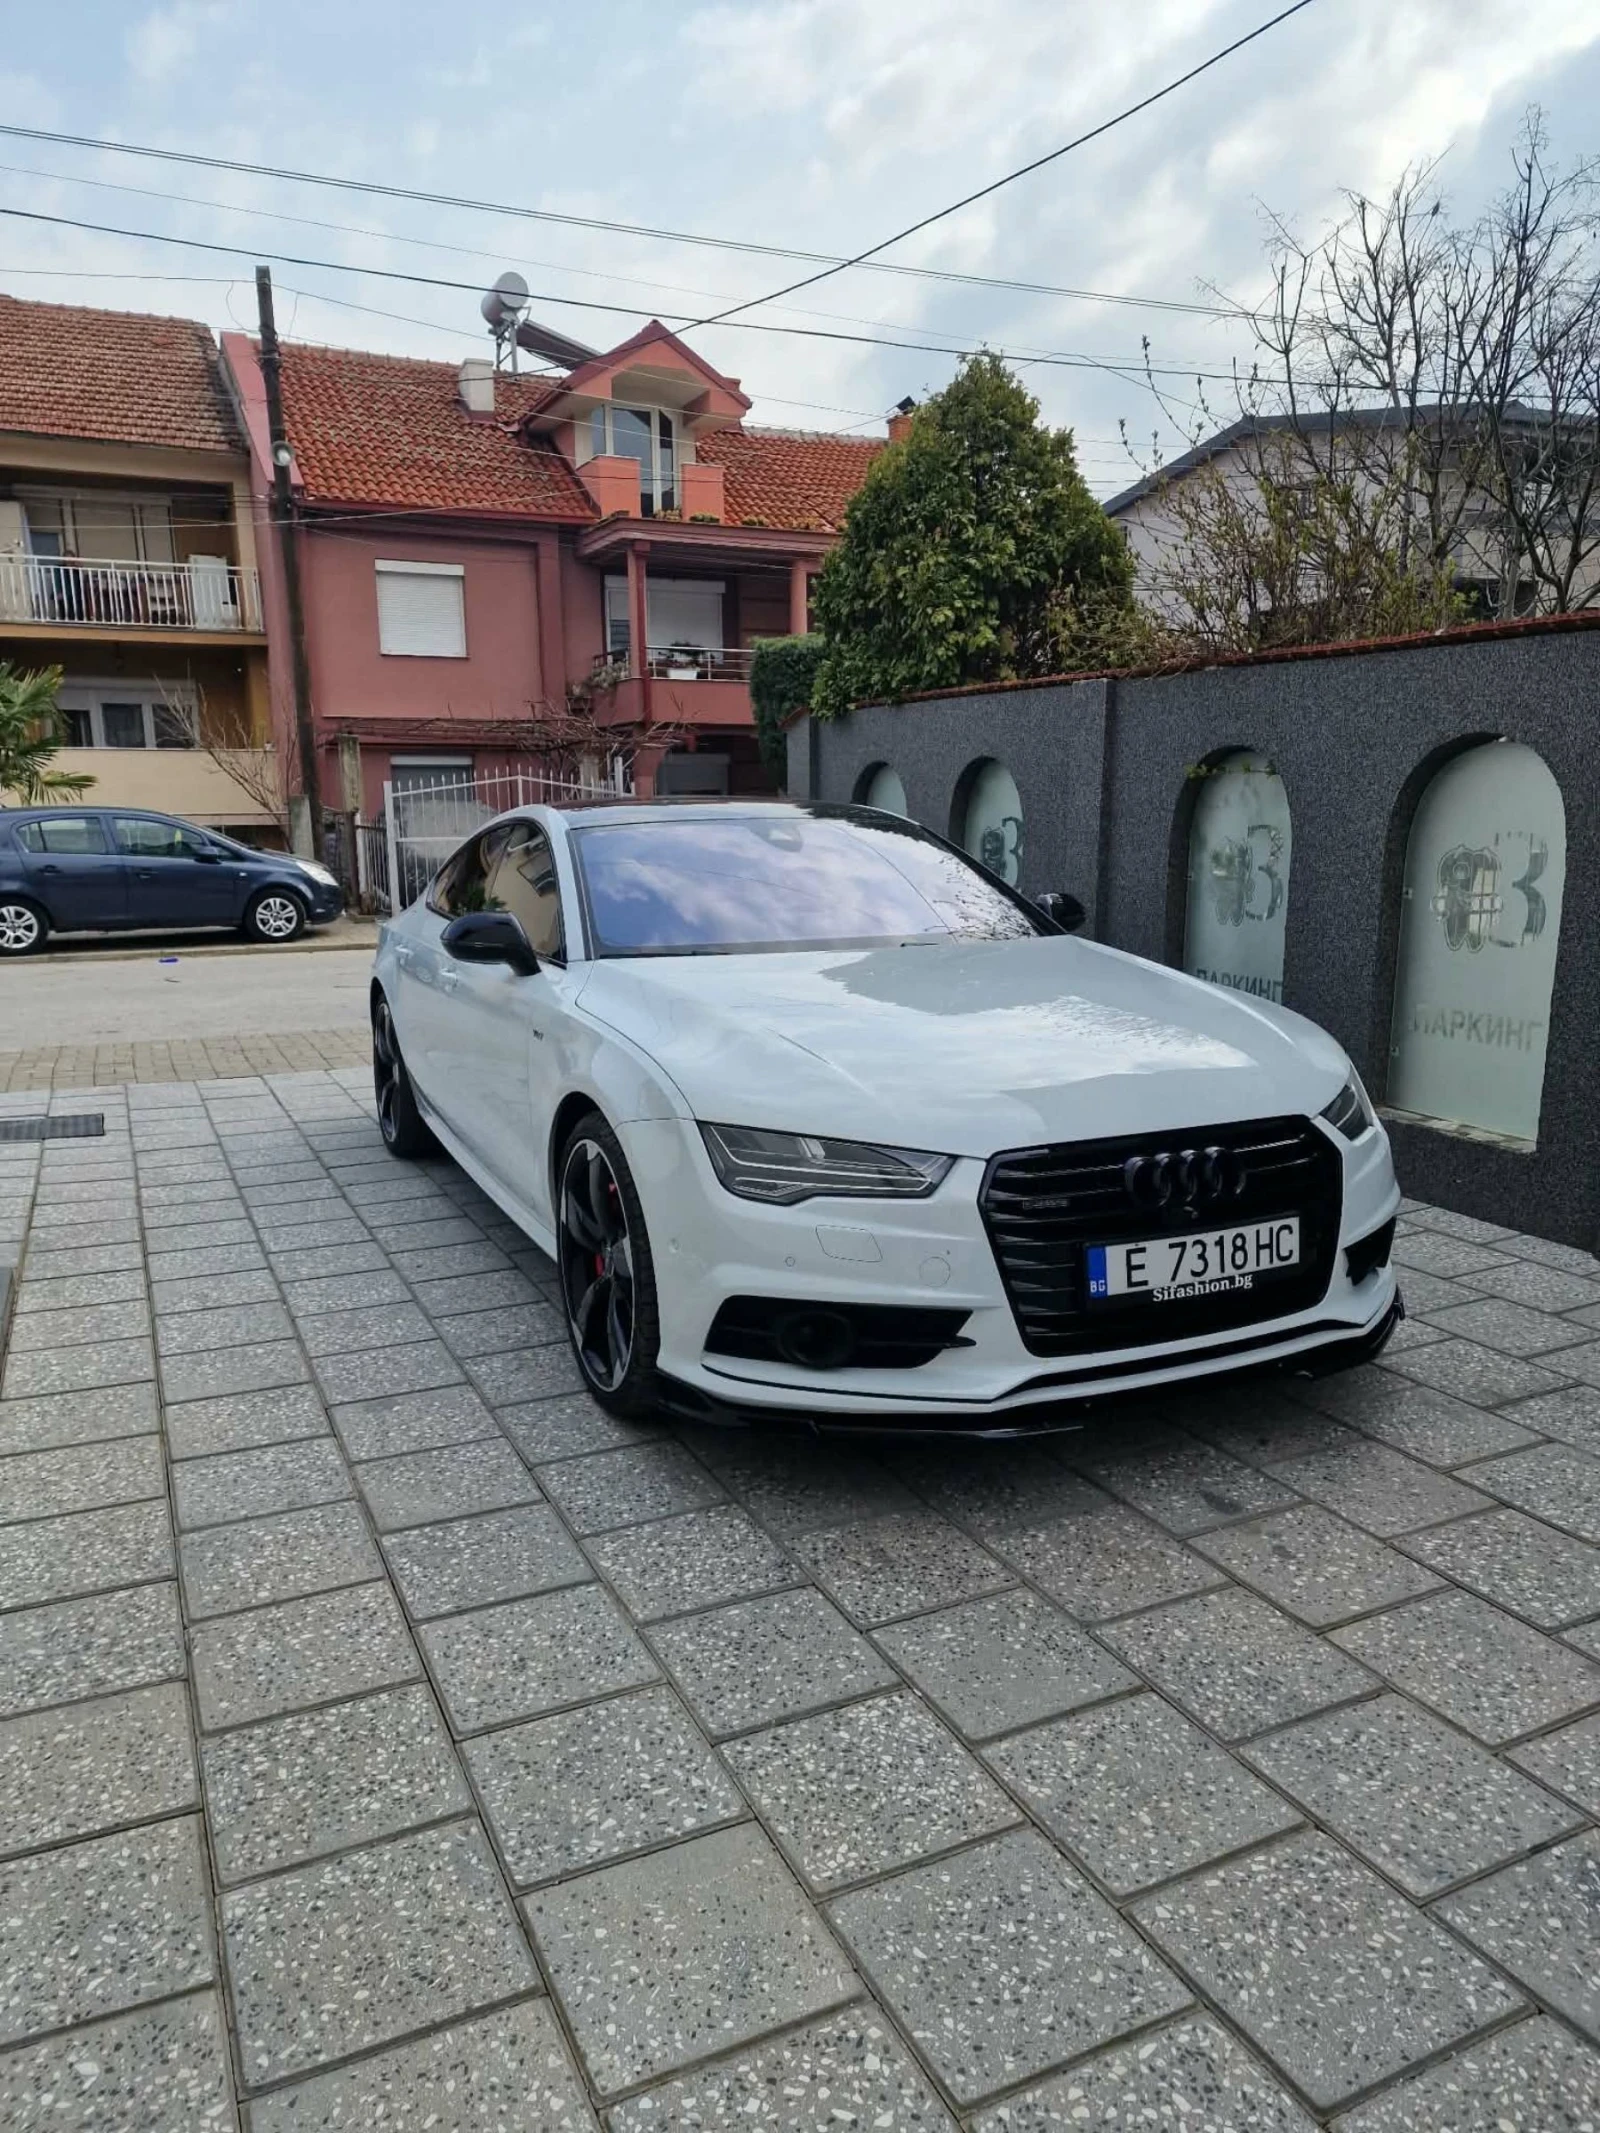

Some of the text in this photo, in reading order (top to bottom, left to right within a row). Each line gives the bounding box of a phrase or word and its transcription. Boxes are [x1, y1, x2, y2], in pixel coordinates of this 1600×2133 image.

[1411, 1004, 1543, 1052] ПАРКИНГ
[1125, 1246, 1149, 1289] E
[1090, 1279, 1106, 1293] BG
[1152, 1273, 1254, 1302] Sifashion.bg
